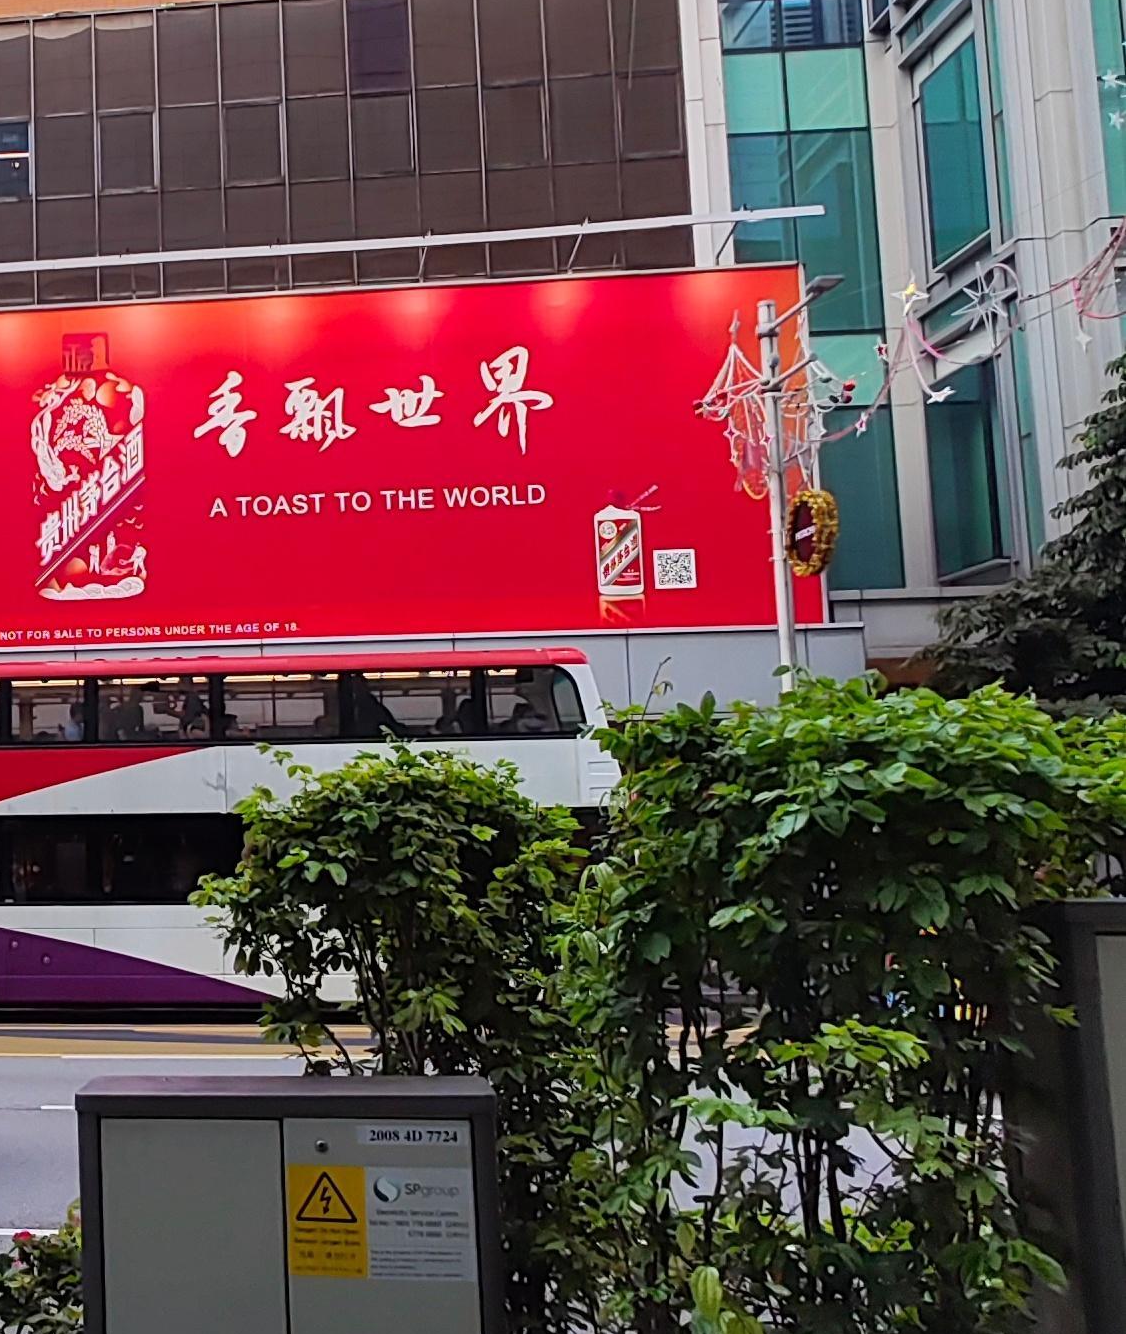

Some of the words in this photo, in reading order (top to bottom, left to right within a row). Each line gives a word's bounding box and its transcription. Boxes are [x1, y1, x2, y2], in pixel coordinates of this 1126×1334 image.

[210, 497, 228, 518] A
[236, 493, 326, 517] TOAST
[334, 491, 372, 512] TO
[383, 488, 435, 510] THE
[442, 484, 546, 508] WORLD
[0, 631, 23, 641] NOT
[27, 630, 50, 640] FOR
[54, 629, 83, 639] SALE
[87, 628, 102, 638] TO
[106, 627, 161, 637] PERSONS
[165, 626, 205, 636] UNDER
[209, 624, 231, 634] THE
[235, 623, 260, 633] AGE
[264, 622, 279, 632] OF
[370, 1130, 400, 1142] 2008
[404, 1130, 422, 1142] 4D
[426, 1131, 458, 1143] 7724
